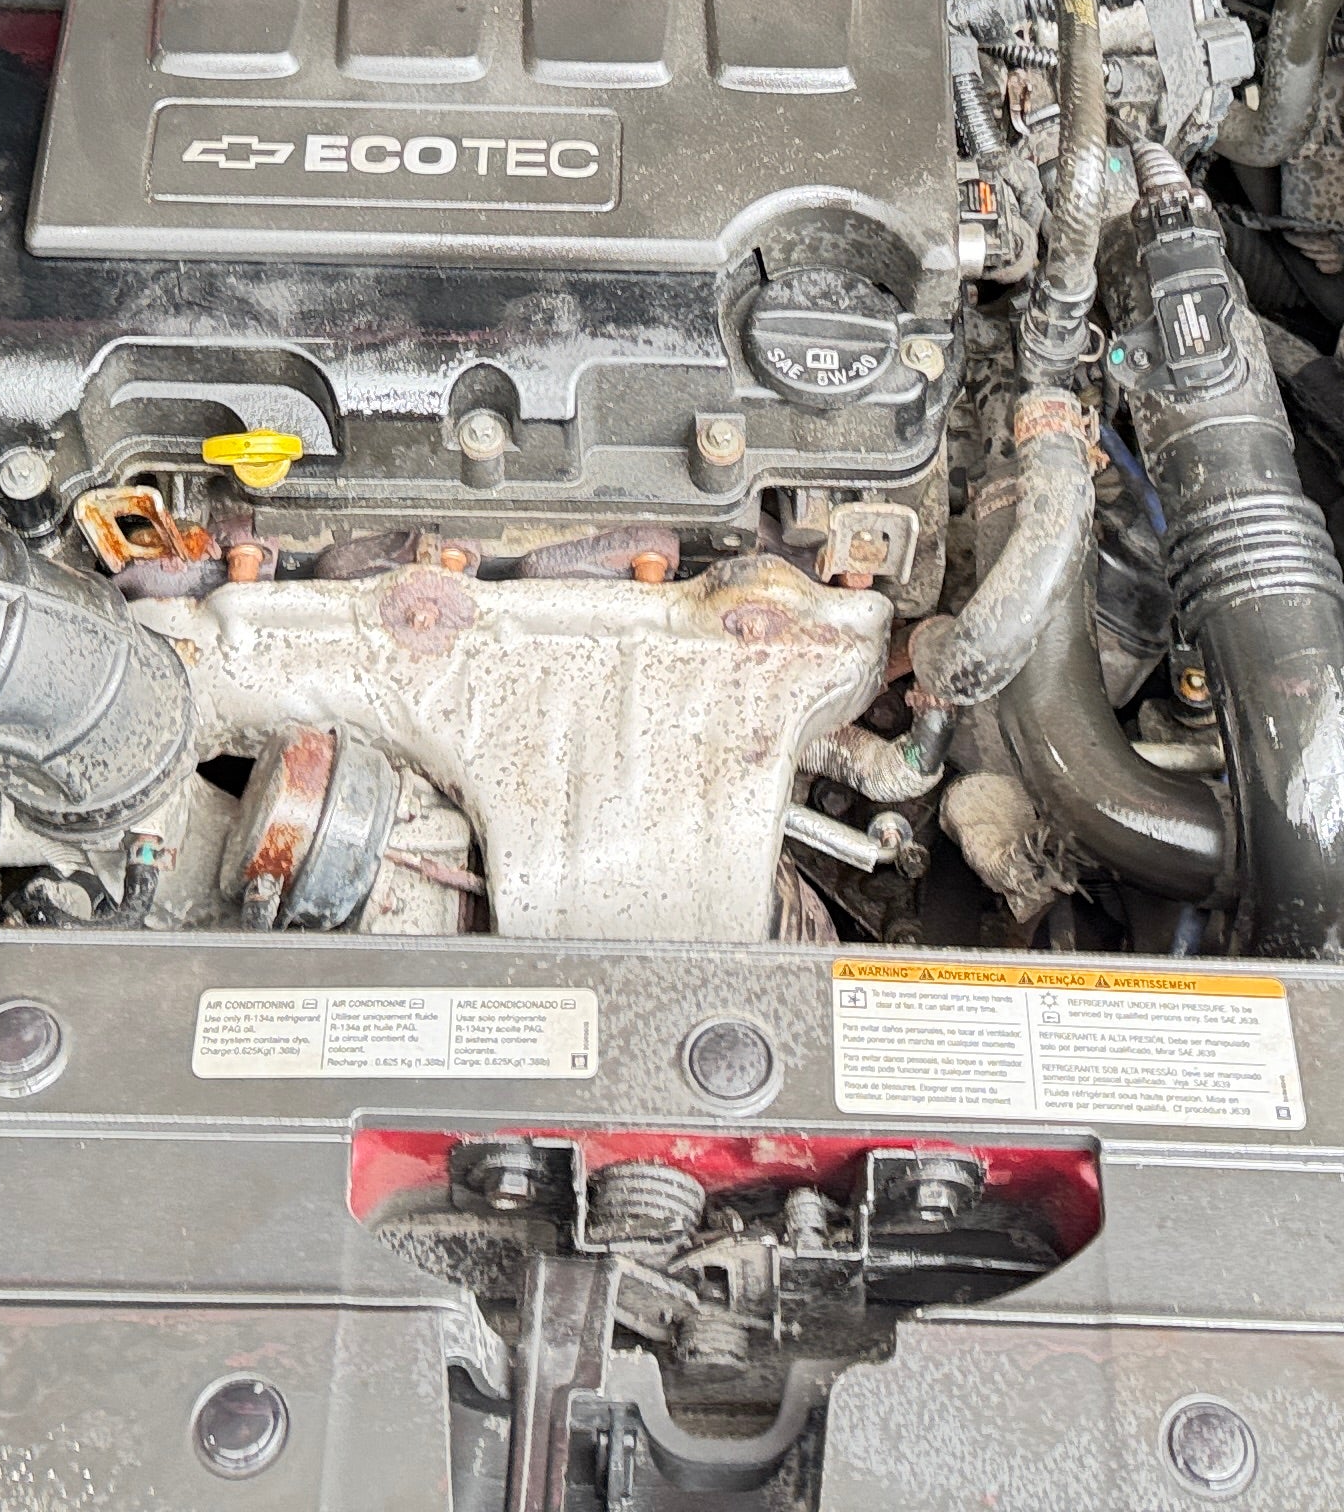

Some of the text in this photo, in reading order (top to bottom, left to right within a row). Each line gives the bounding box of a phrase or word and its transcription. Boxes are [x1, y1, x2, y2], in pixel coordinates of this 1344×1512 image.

[305, 133, 600, 179] ECOTEC
[767, 348, 805, 379] SAE
[858, 967, 908, 978] WARNING
[937, 970, 1006, 982] ADVERTENCIA
[1037, 973, 1086, 987] ATENÇÃO
[1114, 978, 1197, 990] AVERTISSEMENT
